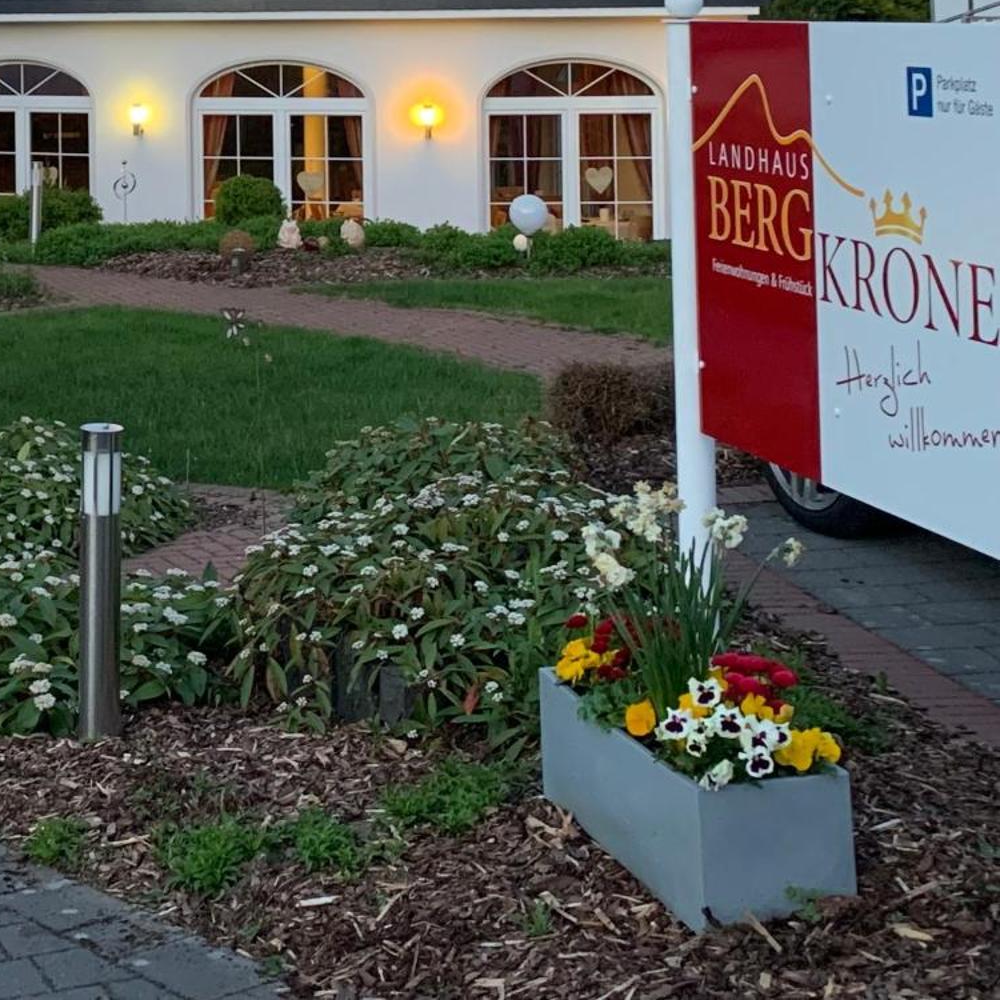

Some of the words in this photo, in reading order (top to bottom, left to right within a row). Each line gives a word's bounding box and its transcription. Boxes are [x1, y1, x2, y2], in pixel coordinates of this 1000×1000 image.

[912, 73, 927, 111] P
[709, 141, 809, 180] LANDHAUS
[707, 175, 813, 261] BERG
[818, 232, 1000, 347] KRONE
